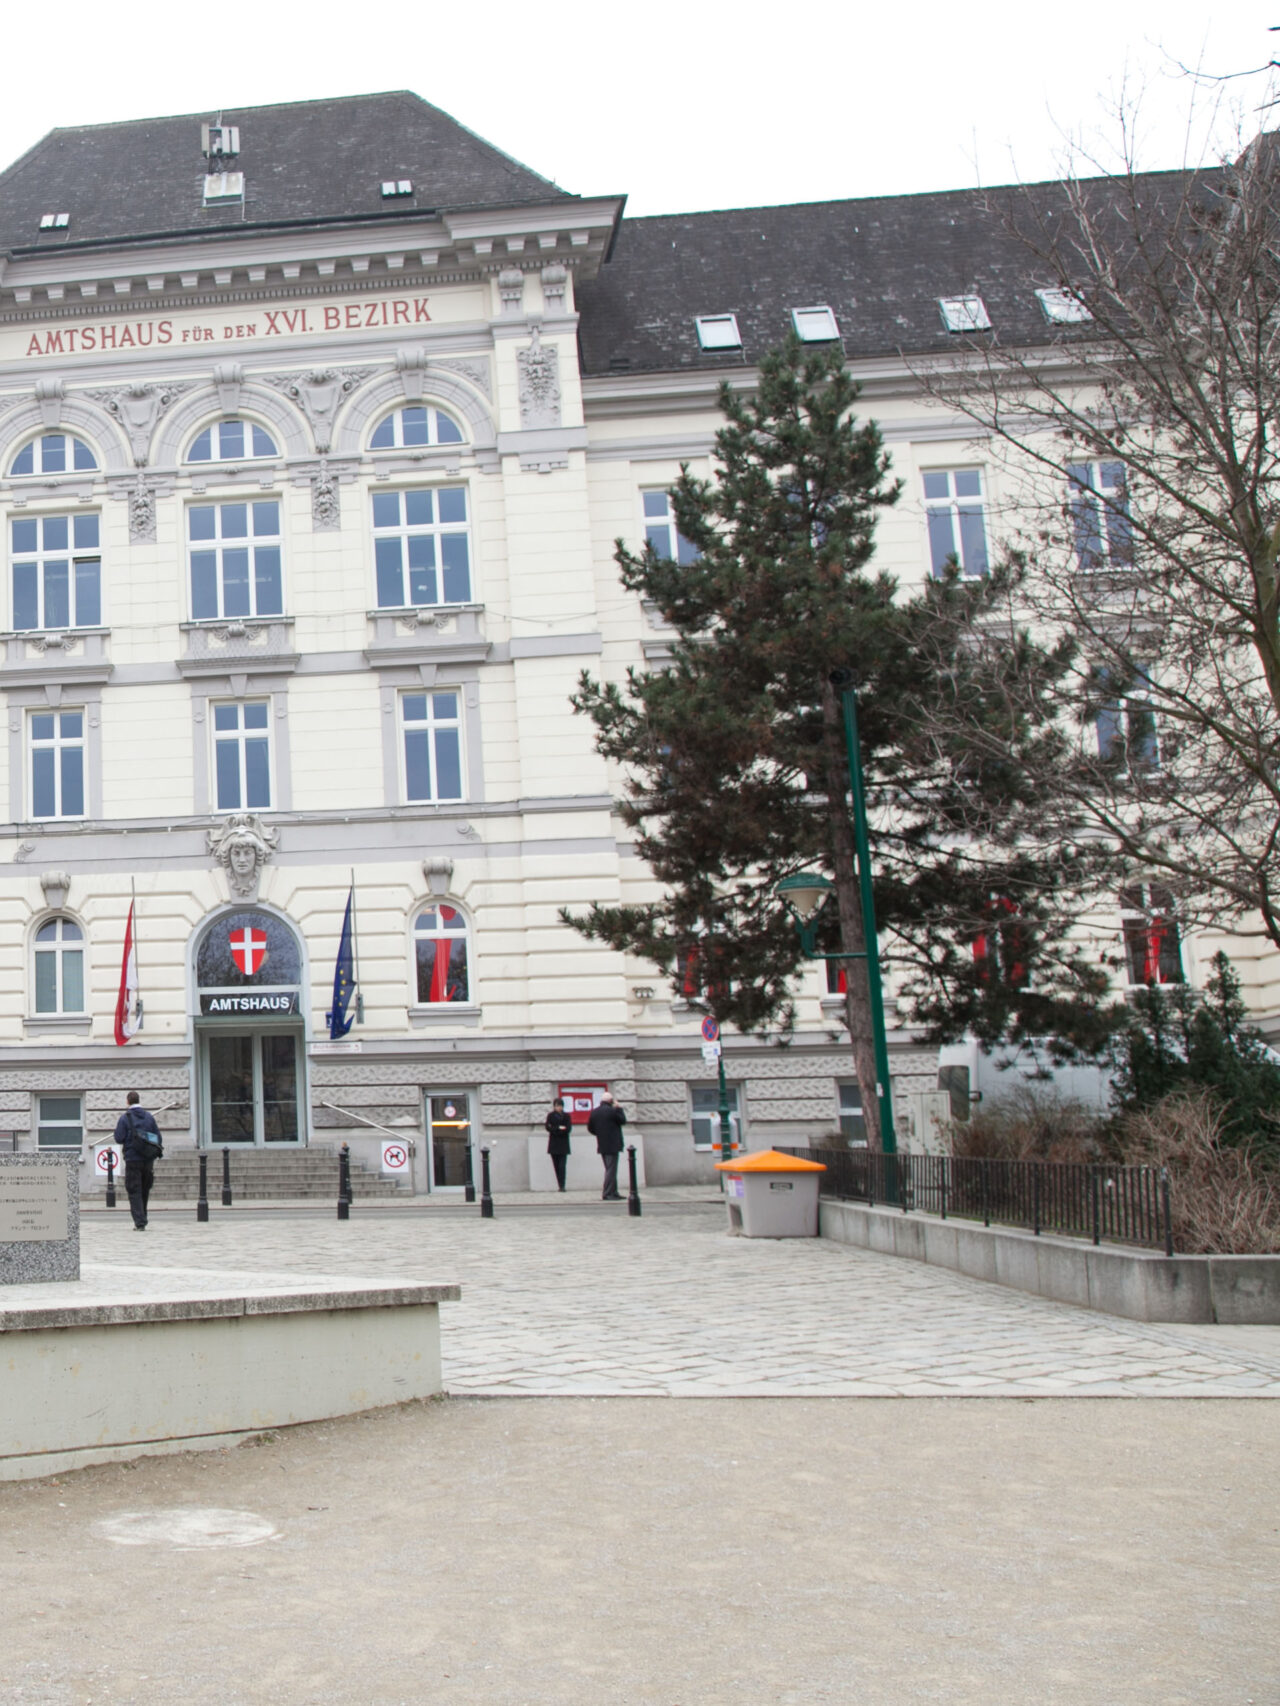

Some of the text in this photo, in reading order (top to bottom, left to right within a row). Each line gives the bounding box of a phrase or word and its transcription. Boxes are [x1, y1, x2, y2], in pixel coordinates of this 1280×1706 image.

[26, 298, 432, 356] AMTSHAUS FÜR DEN XVI. BEZIRK
[209, 996, 290, 1011] AMTSHAUS
